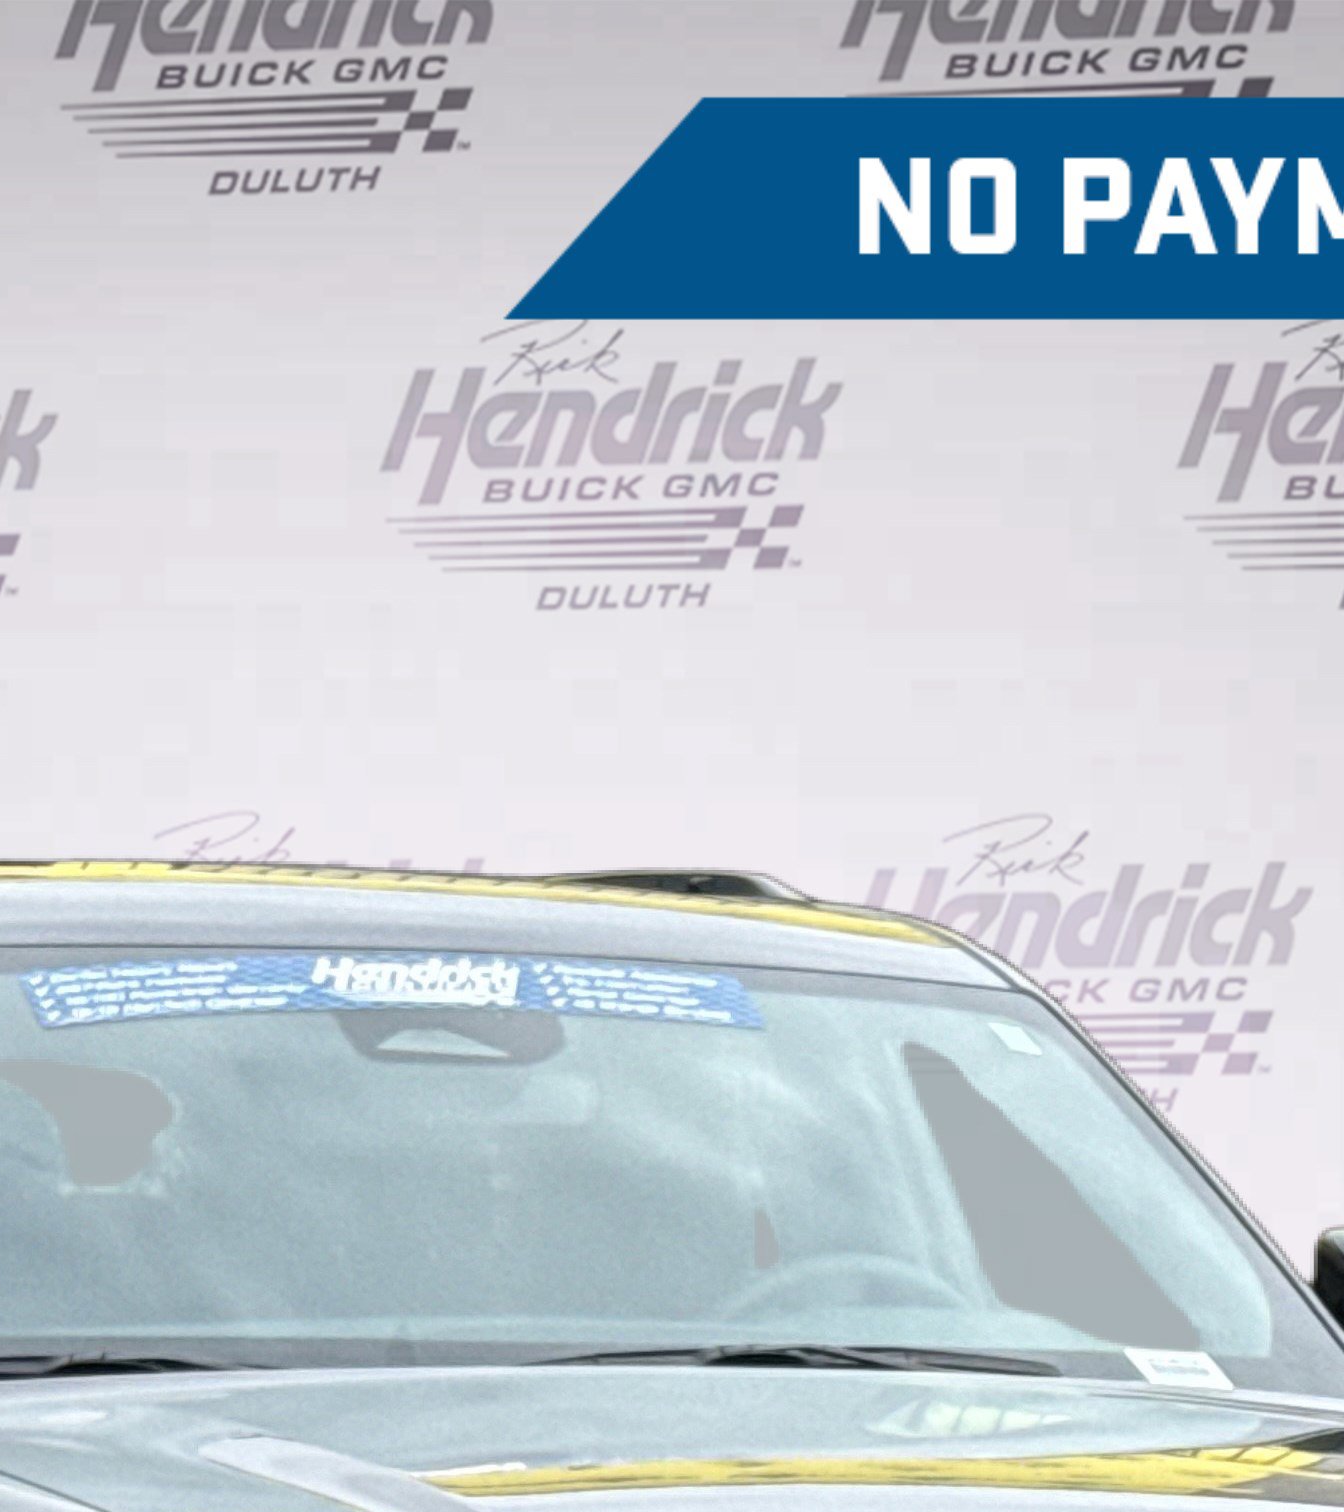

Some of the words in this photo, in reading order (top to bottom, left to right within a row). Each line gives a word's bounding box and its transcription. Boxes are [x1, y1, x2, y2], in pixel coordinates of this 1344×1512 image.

[156, 60, 315, 90] BUICK
[332, 55, 449, 84] GMC
[945, 48, 1111, 80] BUICK
[1128, 44, 1248, 72] GMC
[208, 166, 381, 196] DULUTH
[379, 357, 843, 506] Hendrick
[482, 475, 644, 503] BUICK
[661, 472, 780, 499] GMC
[535, 582, 711, 611] DULUTH
[1129, 978, 1248, 1002] GMC
